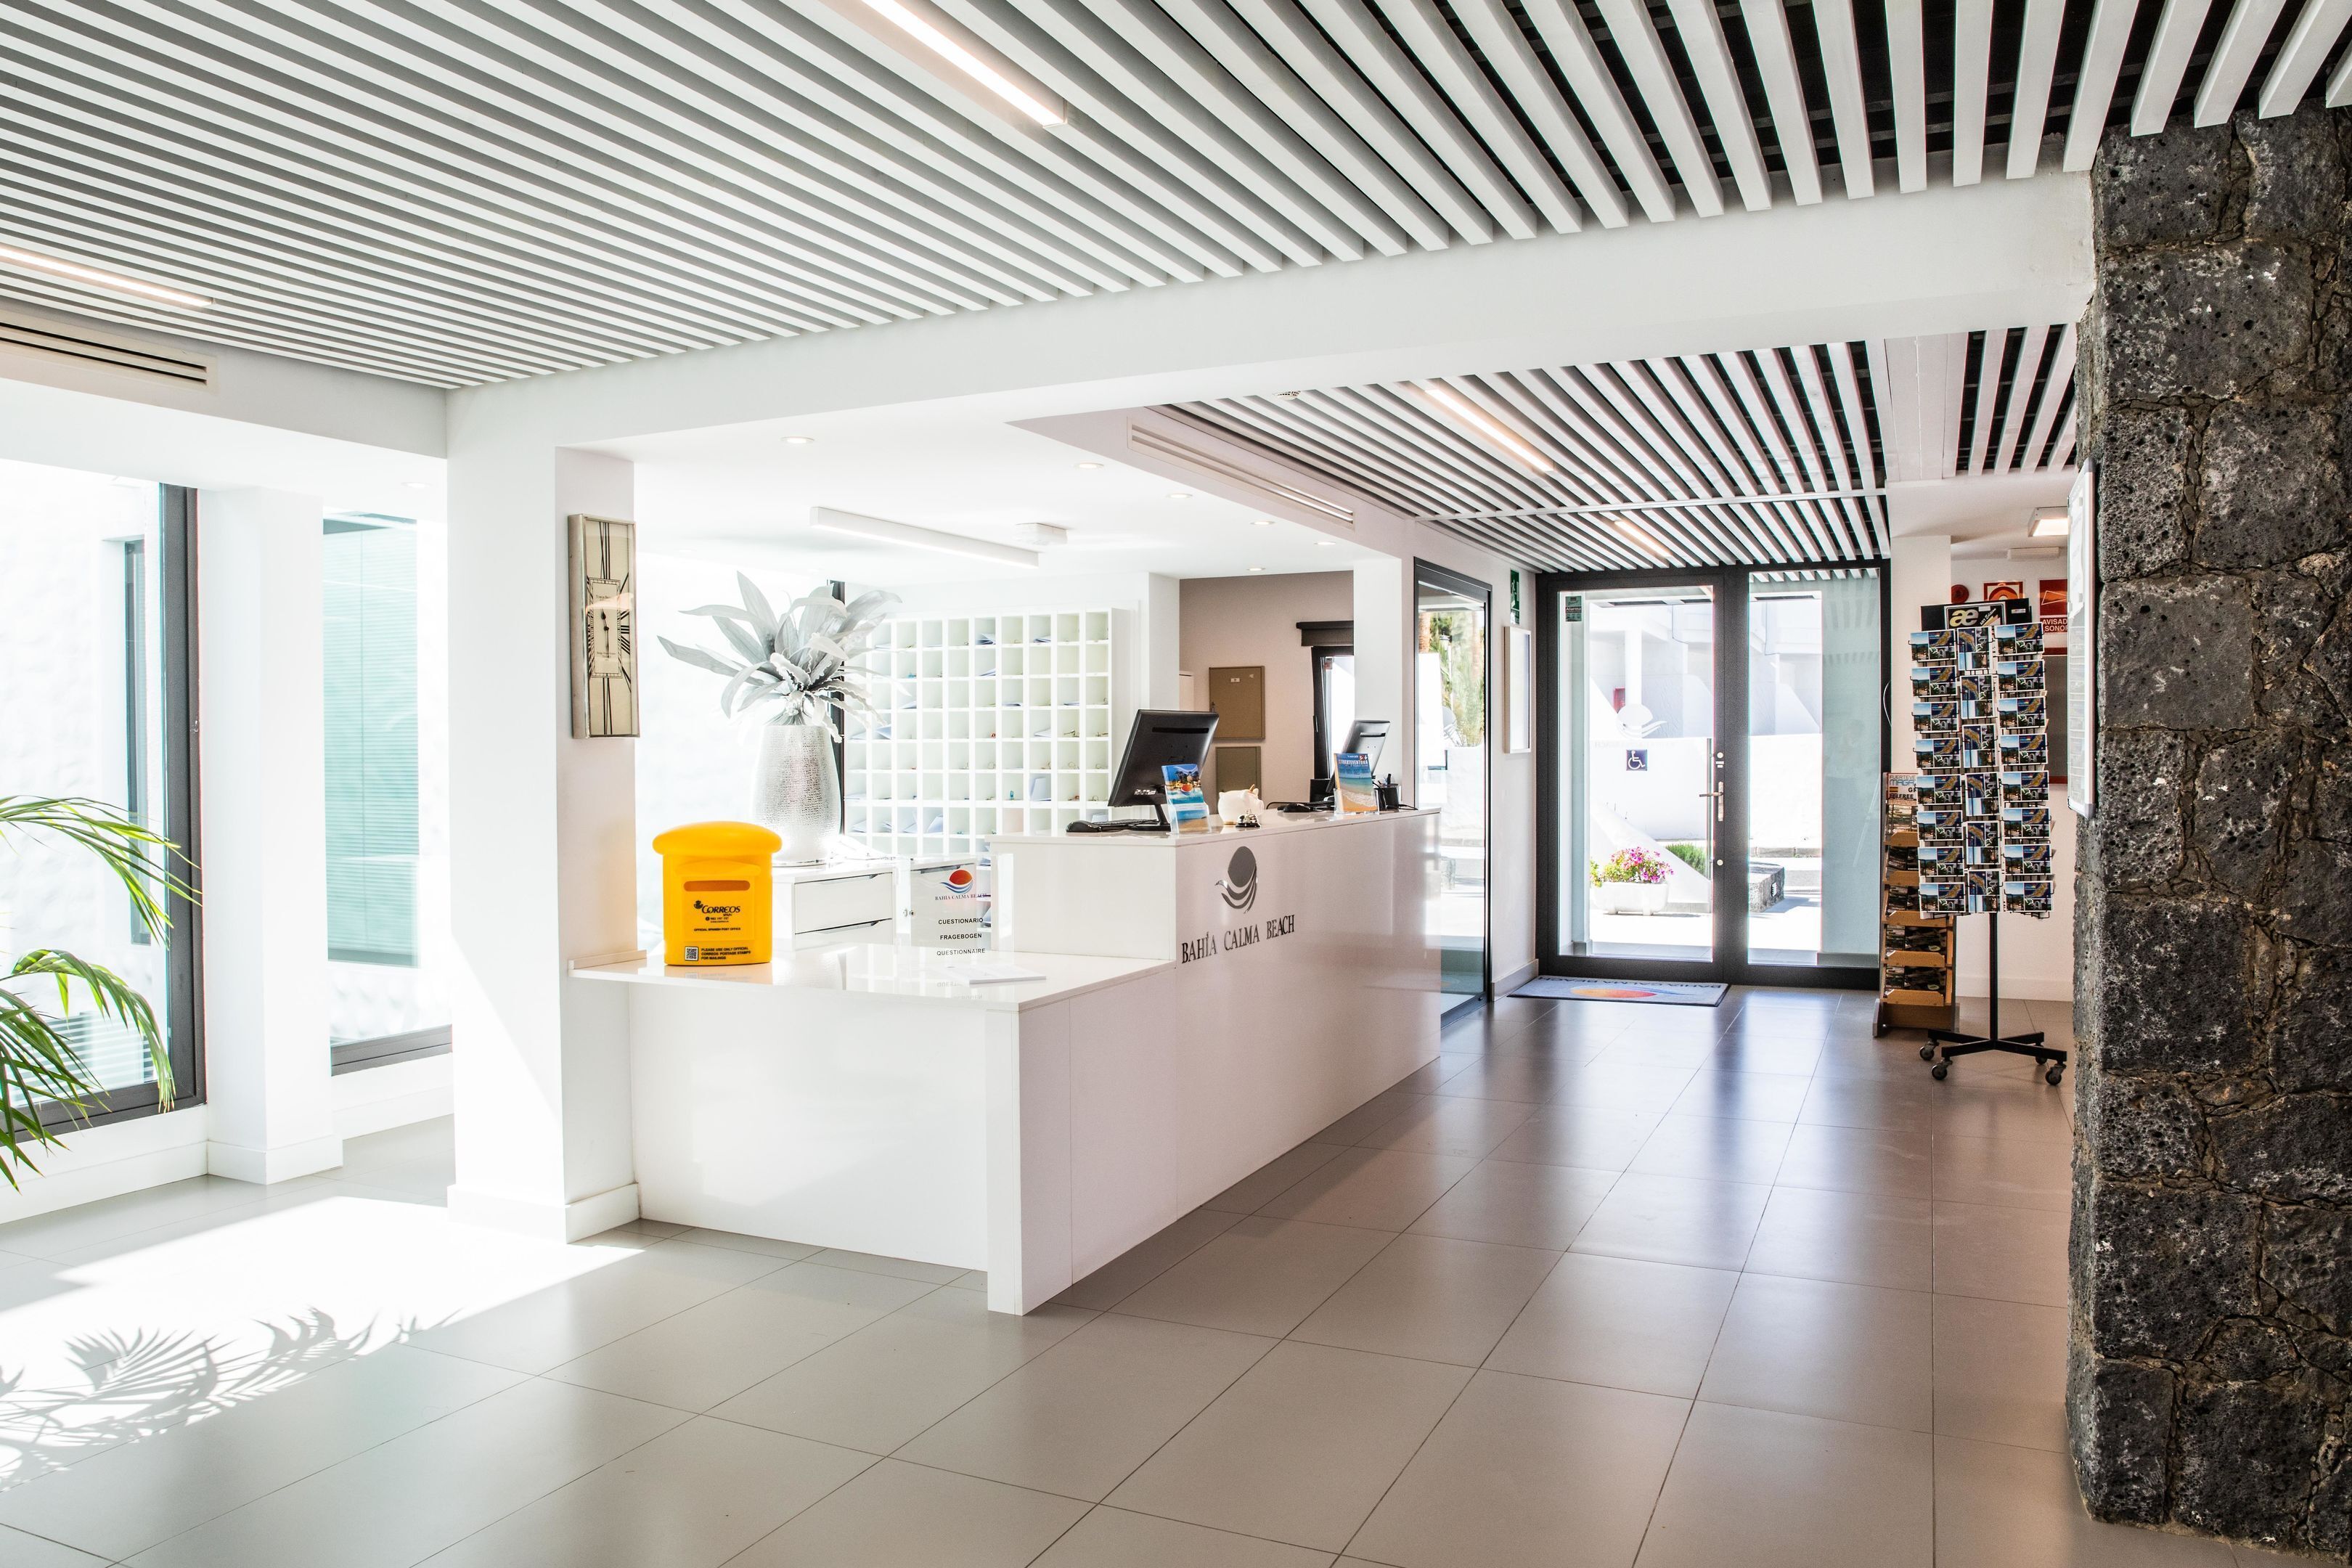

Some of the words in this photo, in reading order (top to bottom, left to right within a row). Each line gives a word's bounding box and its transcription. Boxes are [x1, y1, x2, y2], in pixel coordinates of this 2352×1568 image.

[701, 905, 741, 914] CORREOS
[1182, 931, 1217, 964] BAHÍA
[1224, 924, 1260, 951] CALMA
[1267, 915, 1295, 939] BEACH
